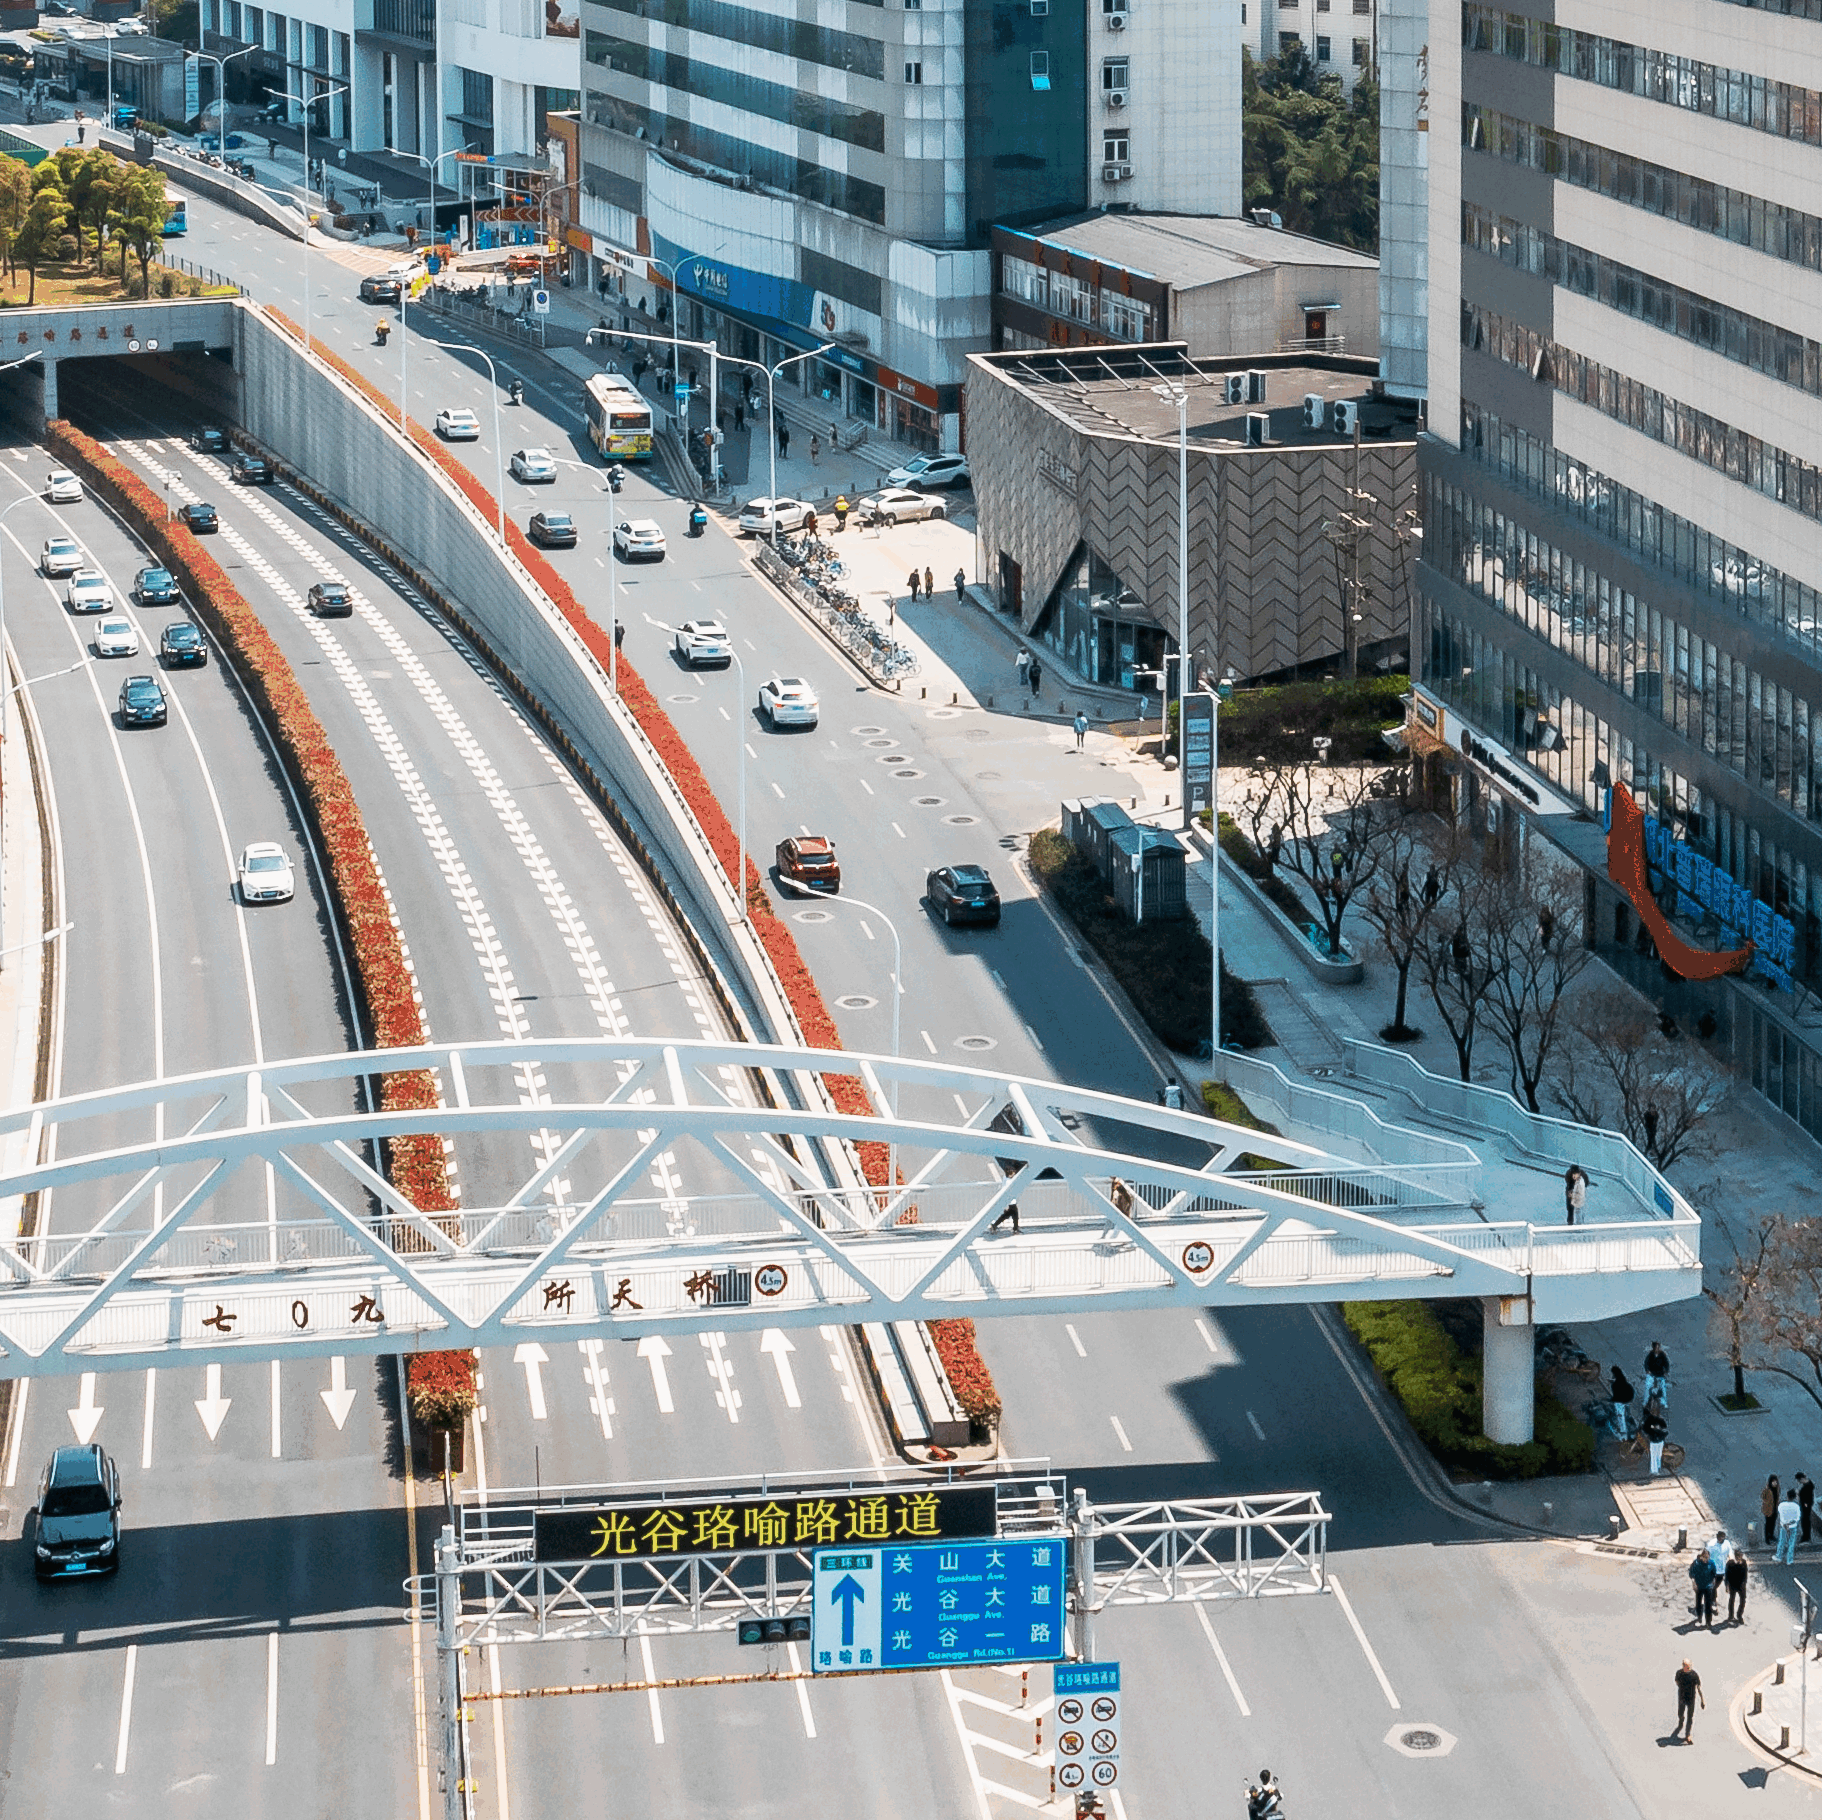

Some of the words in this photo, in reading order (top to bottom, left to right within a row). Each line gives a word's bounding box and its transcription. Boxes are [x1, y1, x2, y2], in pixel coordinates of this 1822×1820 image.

[1645, 813, 1795, 972] 北普瑞眼科医院
[590, 1492, 942, 1558] 光谷珞喻路通道
[892, 1546, 1052, 1574] 关山大道
[892, 1585, 1052, 1613] 光谷大道
[892, 1623, 1051, 1650] 光谷一路
[819, 1649, 872, 1665] 珞喻路
[1098, 1768, 1112, 1779] 60
